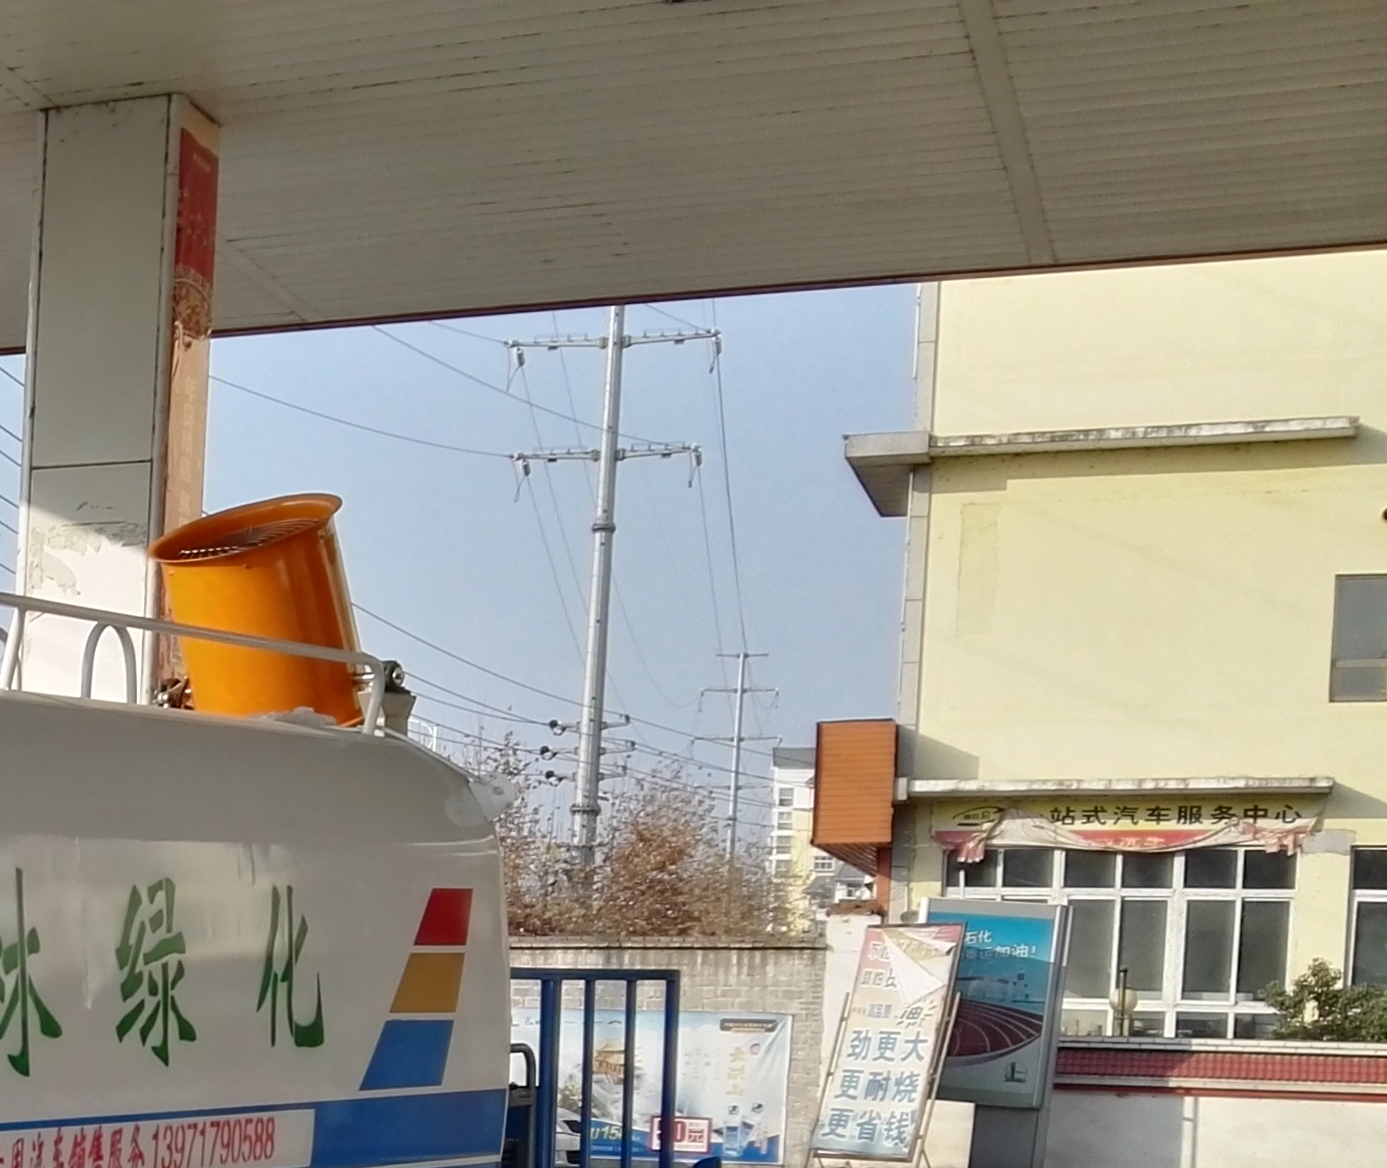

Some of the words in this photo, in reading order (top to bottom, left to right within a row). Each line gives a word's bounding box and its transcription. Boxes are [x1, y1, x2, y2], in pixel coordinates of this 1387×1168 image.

[1039, 803, 1304, 827] 站式汽车服务中心
[846, 1029, 929, 1063] 劲更大
[833, 1068, 922, 1103] 更耐烧
[820, 1107, 912, 1147] 更省钱
